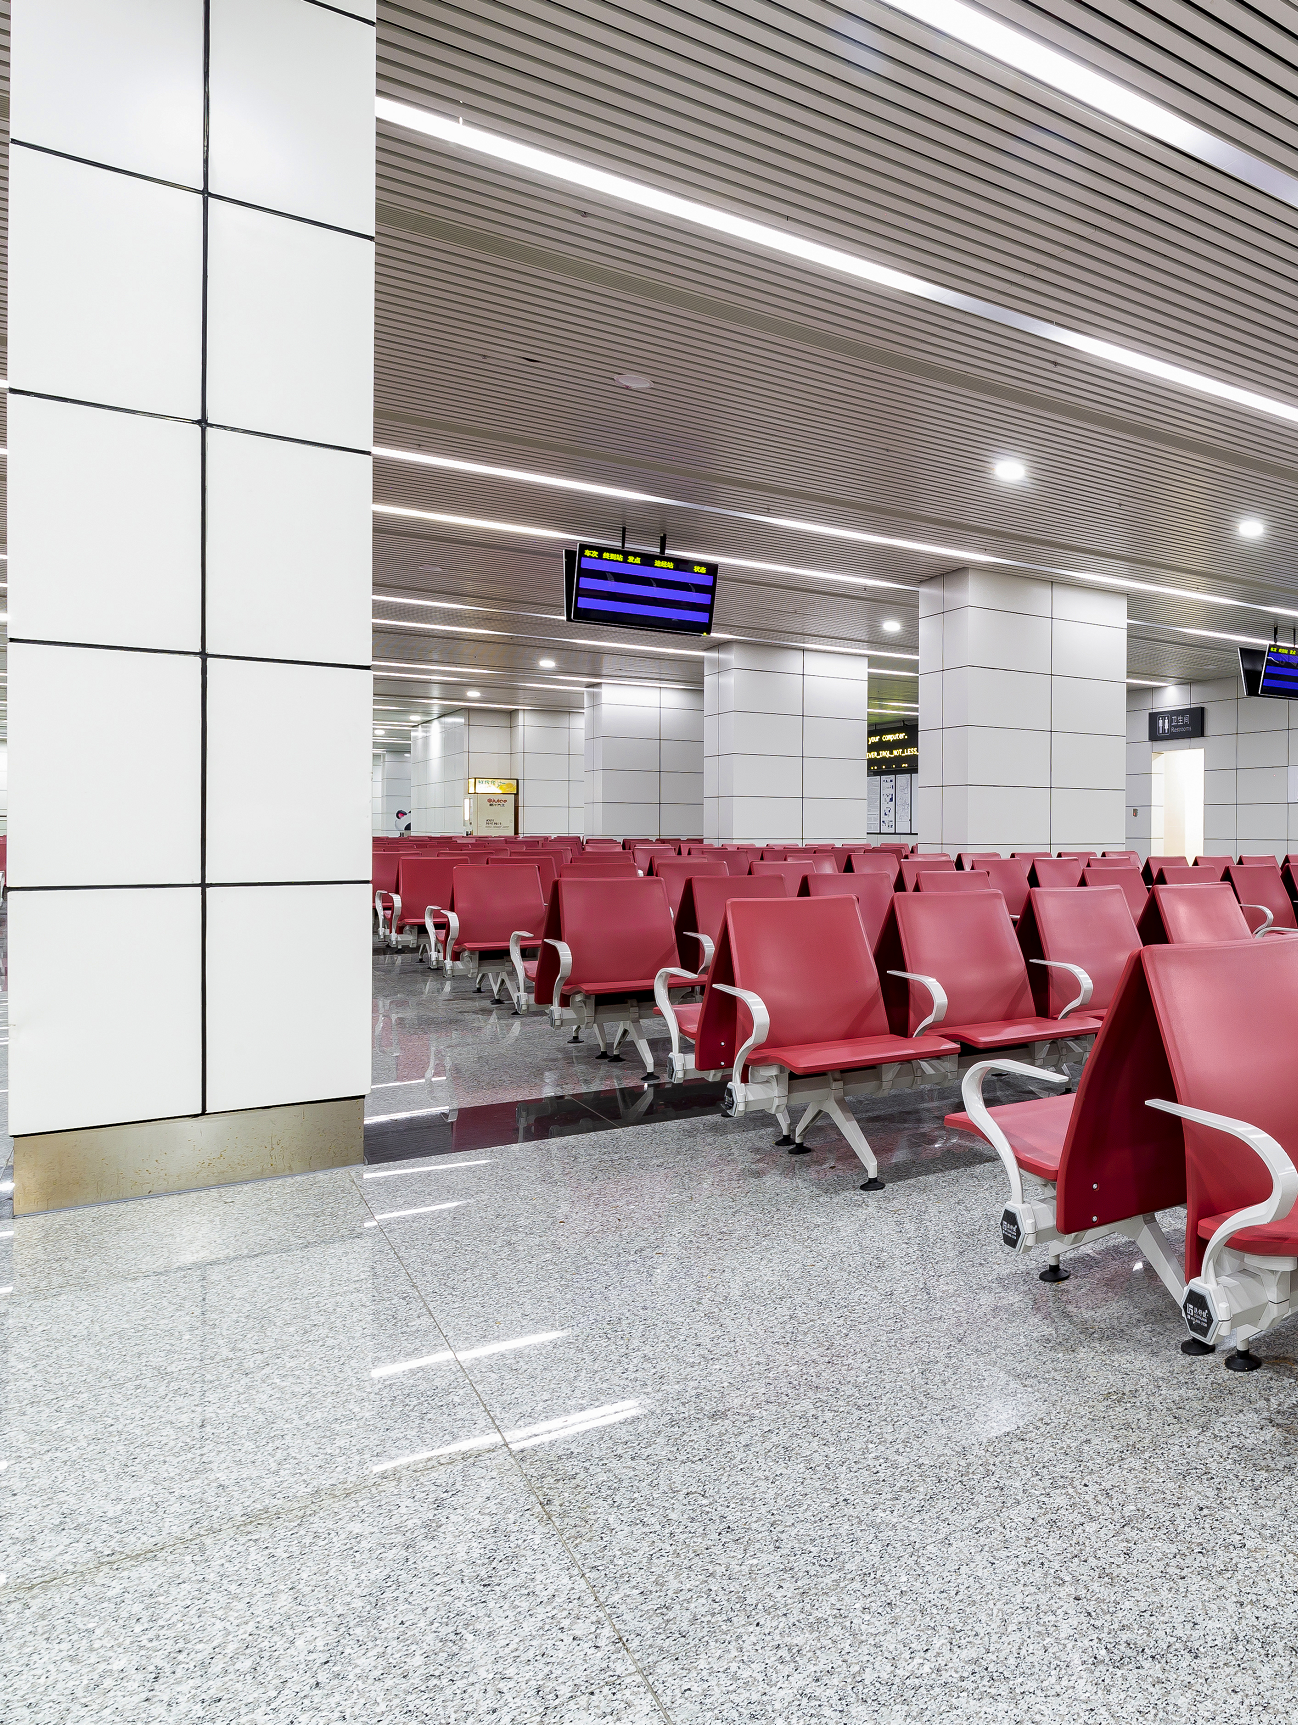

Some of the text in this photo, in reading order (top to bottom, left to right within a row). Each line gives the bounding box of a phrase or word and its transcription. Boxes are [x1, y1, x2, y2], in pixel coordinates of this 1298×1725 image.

[1171, 714, 1190, 726] 卫生间
[868, 732, 908, 745] your computer.
